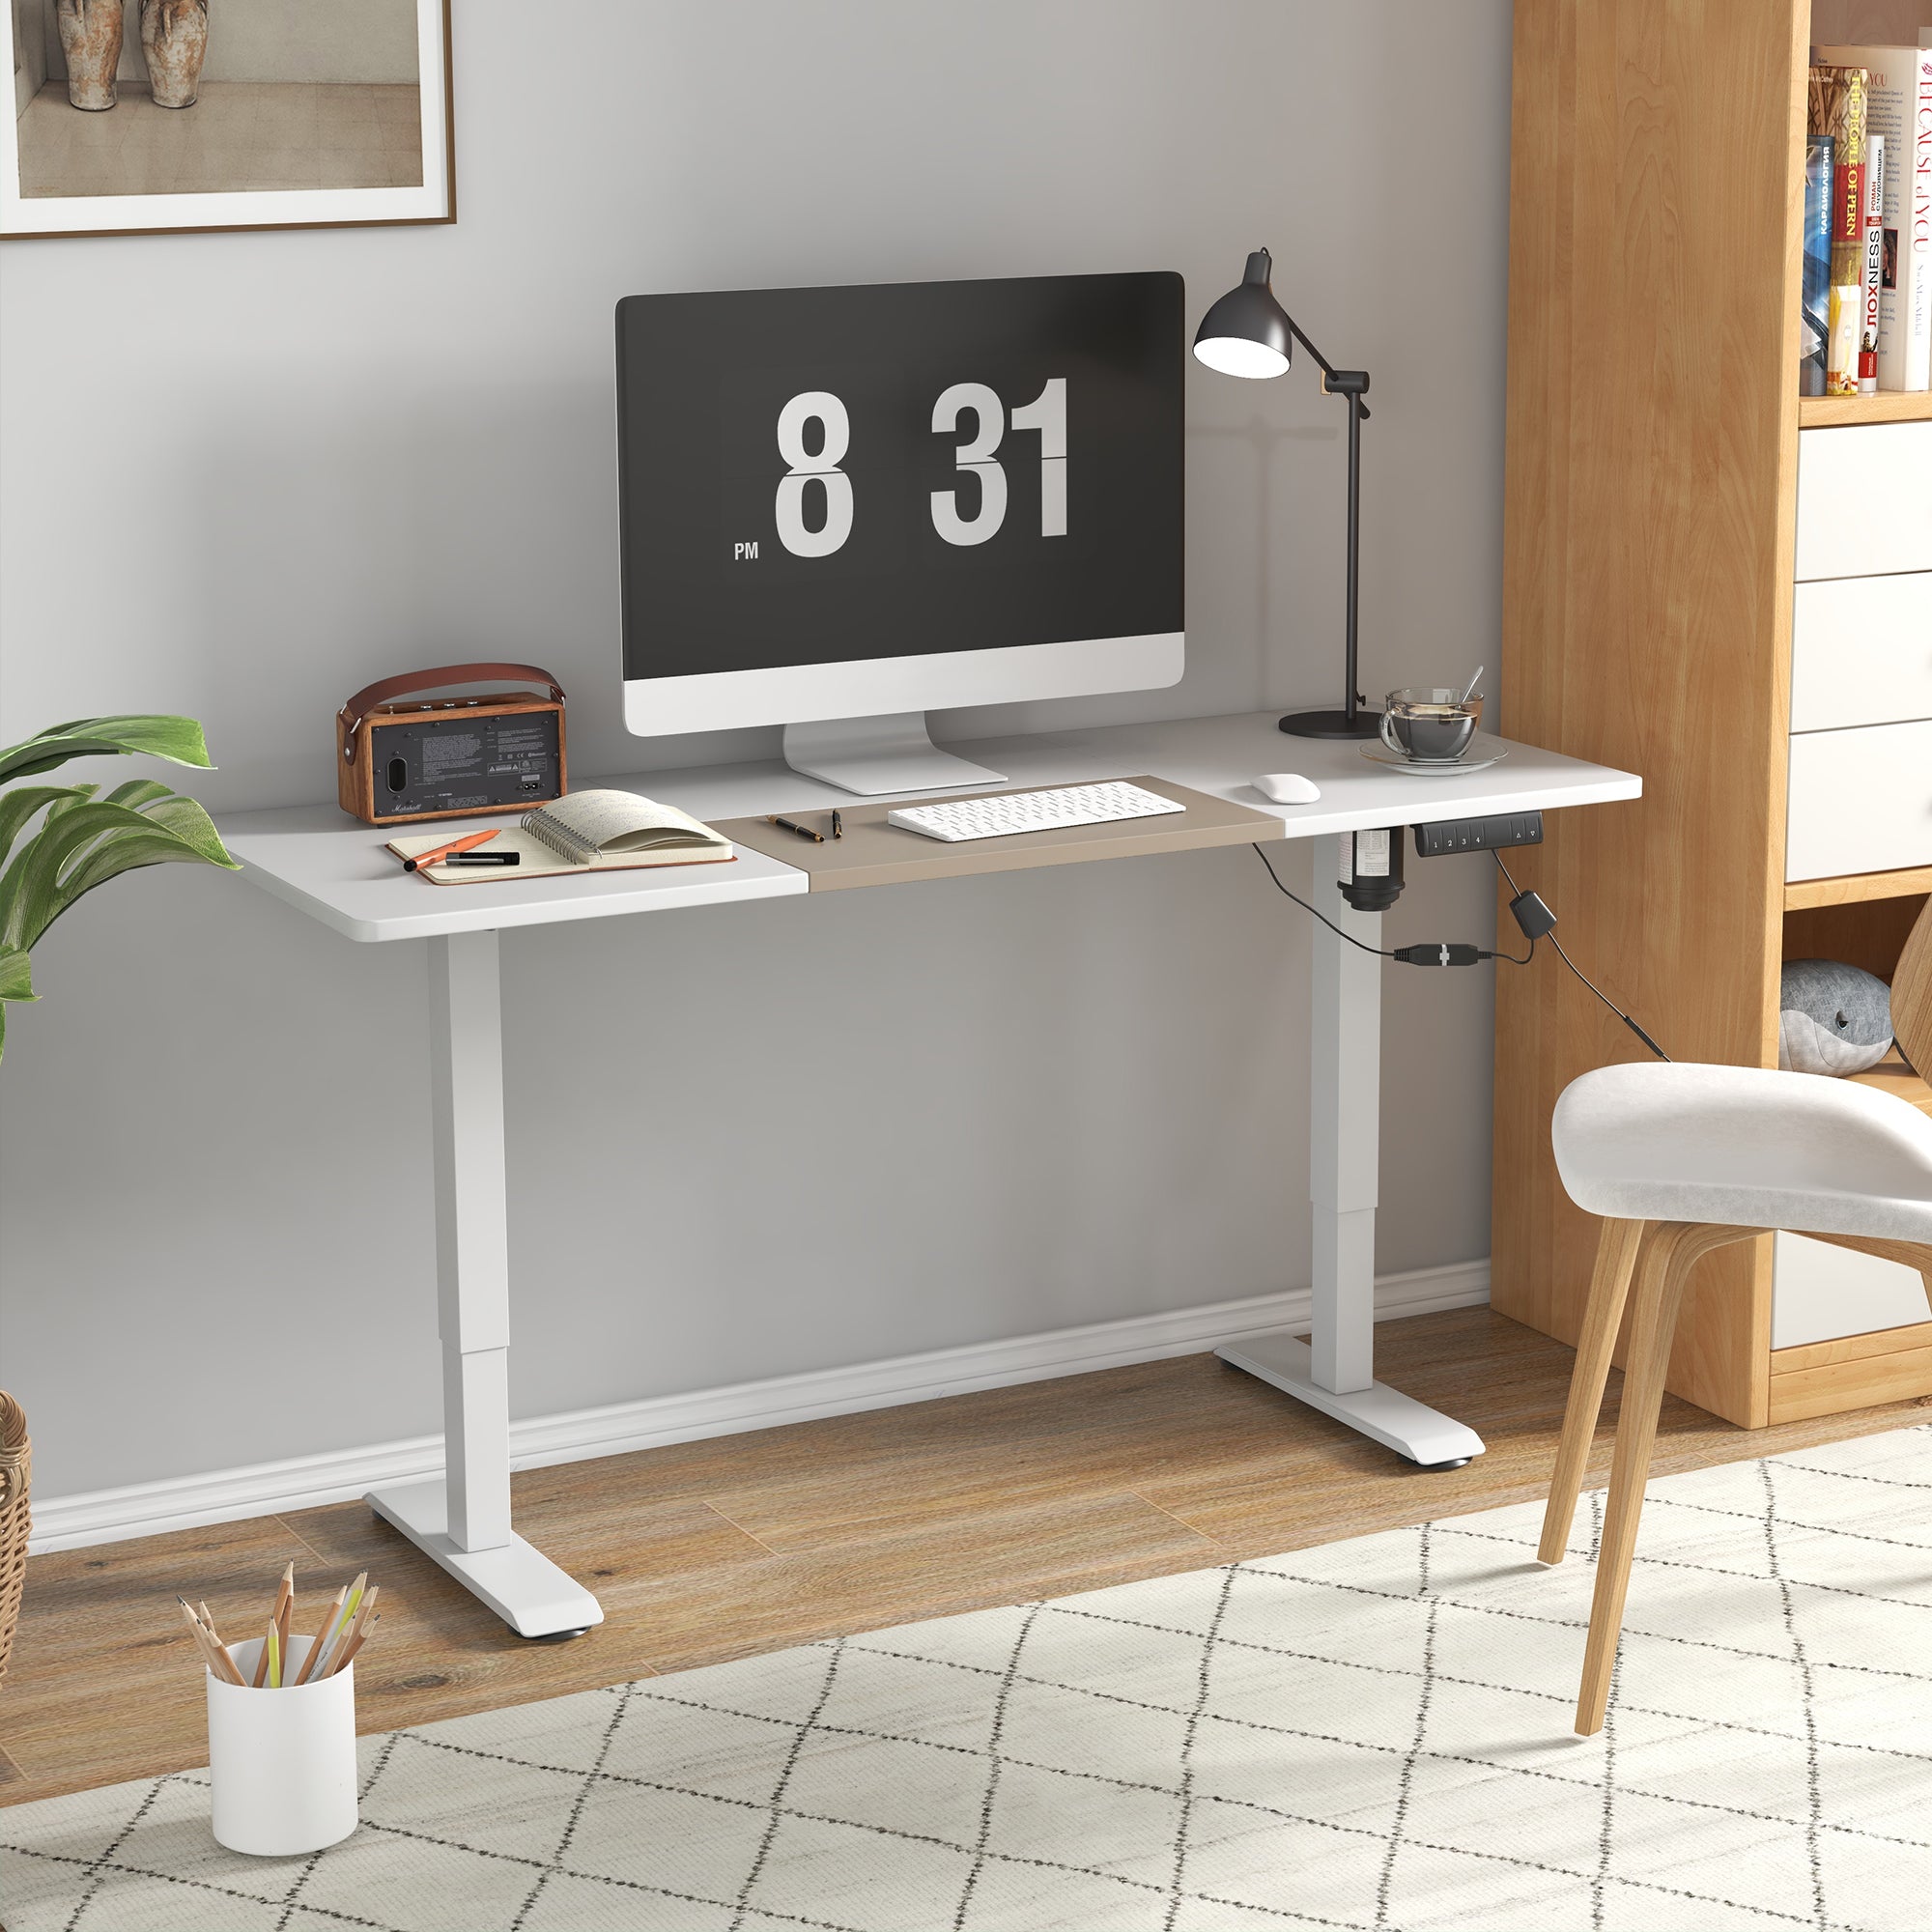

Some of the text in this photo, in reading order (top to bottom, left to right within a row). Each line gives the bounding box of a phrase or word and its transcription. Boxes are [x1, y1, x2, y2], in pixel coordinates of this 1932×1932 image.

[1869, 72, 1888, 87] YOU
[1846, 73, 1861, 236] THE PEOPLE OF PERN
[1917, 82, 1932, 181] BECAUSE
[1820, 146, 1831, 235] КАРДИОЛОГИЯ
[1914, 205, 1930, 253] YOU
[776, 377, 1067, 558] 8 31
[734, 541, 758, 560] PM
